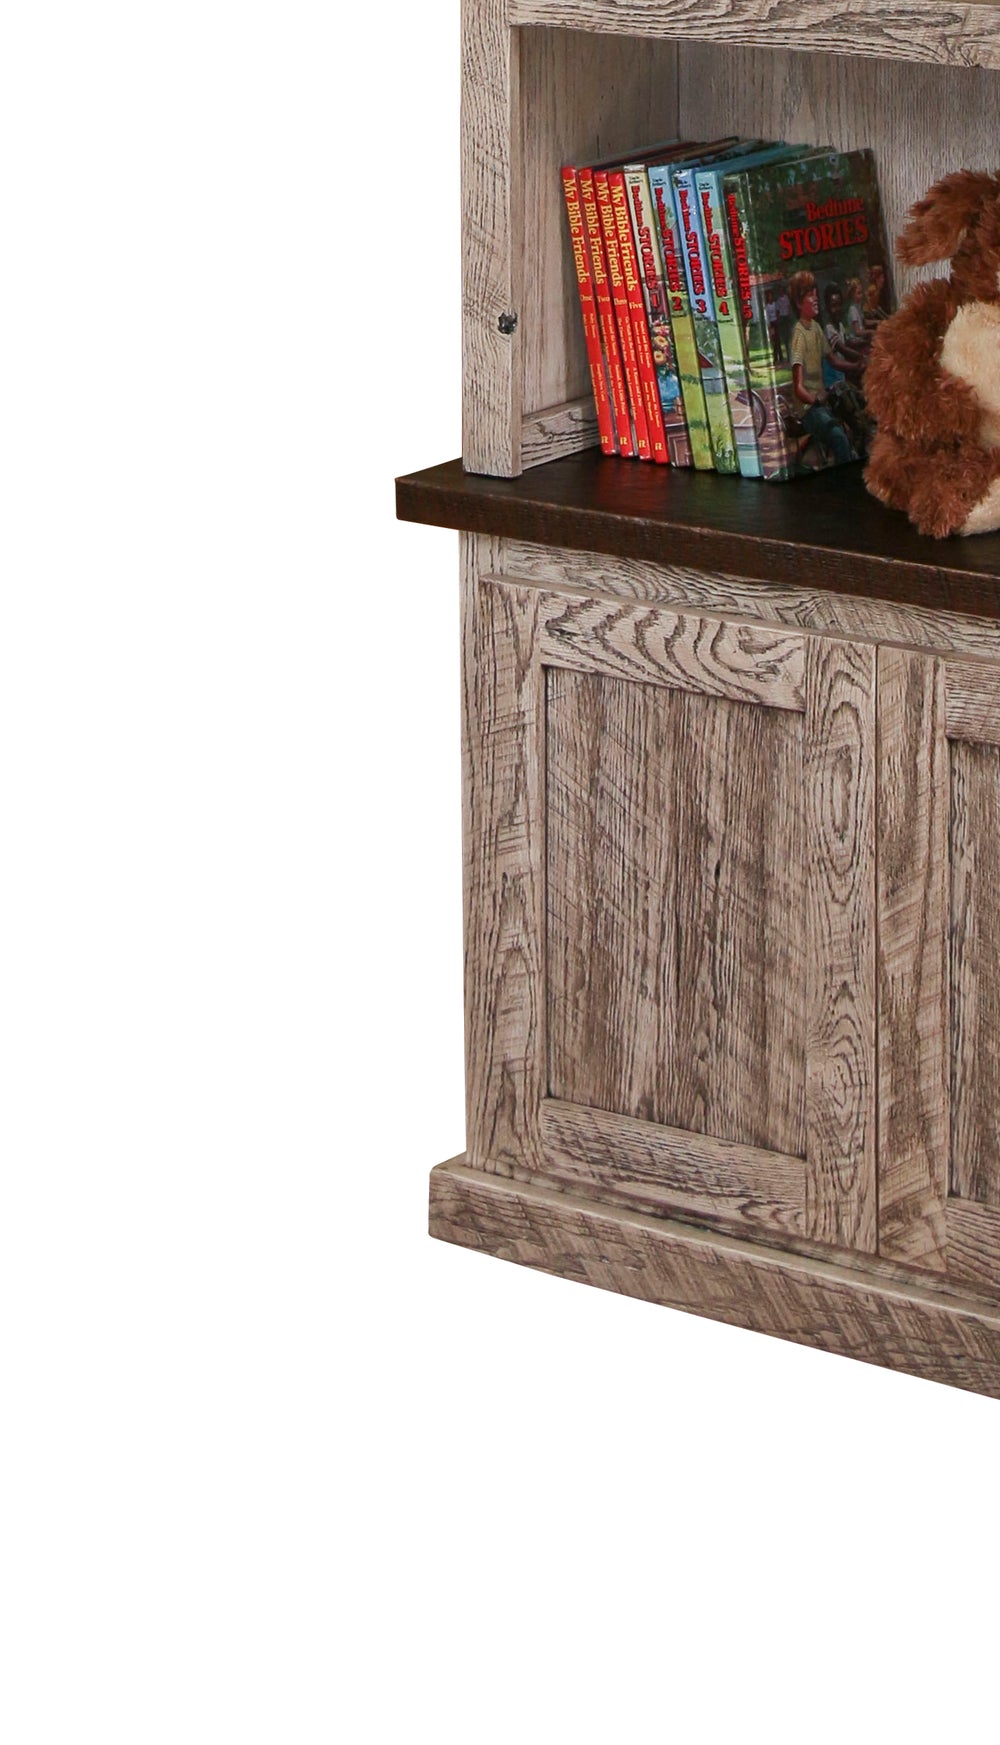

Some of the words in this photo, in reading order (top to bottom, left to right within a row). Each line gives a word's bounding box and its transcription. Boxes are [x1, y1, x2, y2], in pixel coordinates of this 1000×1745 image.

[563, 179, 577, 200] My
[581, 179, 594, 200] My
[596, 181, 609, 202] My
[611, 185, 623, 205] My
[805, 197, 864, 222] Bedtime
[567, 201, 583, 234] Bible
[584, 202, 600, 235] Bible
[601, 204, 616, 237] Bible
[614, 206, 629, 241] Bible
[778, 214, 869, 261] STORIES
[572, 235, 590, 284] Friends
[589, 237, 607, 285] Friends
[606, 239, 623, 287] Friends
[619, 242, 638, 291] Friends
[638, 226, 658, 290] STORIES
[662, 228, 680, 293] STORIES
[672, 296, 683, 311] 2
[685, 231, 705, 295] STORIES
[695, 299, 707, 313] 3
[709, 233, 728, 297] STORIES
[719, 301, 729, 316] 4
[734, 237, 752, 299] STORIES
